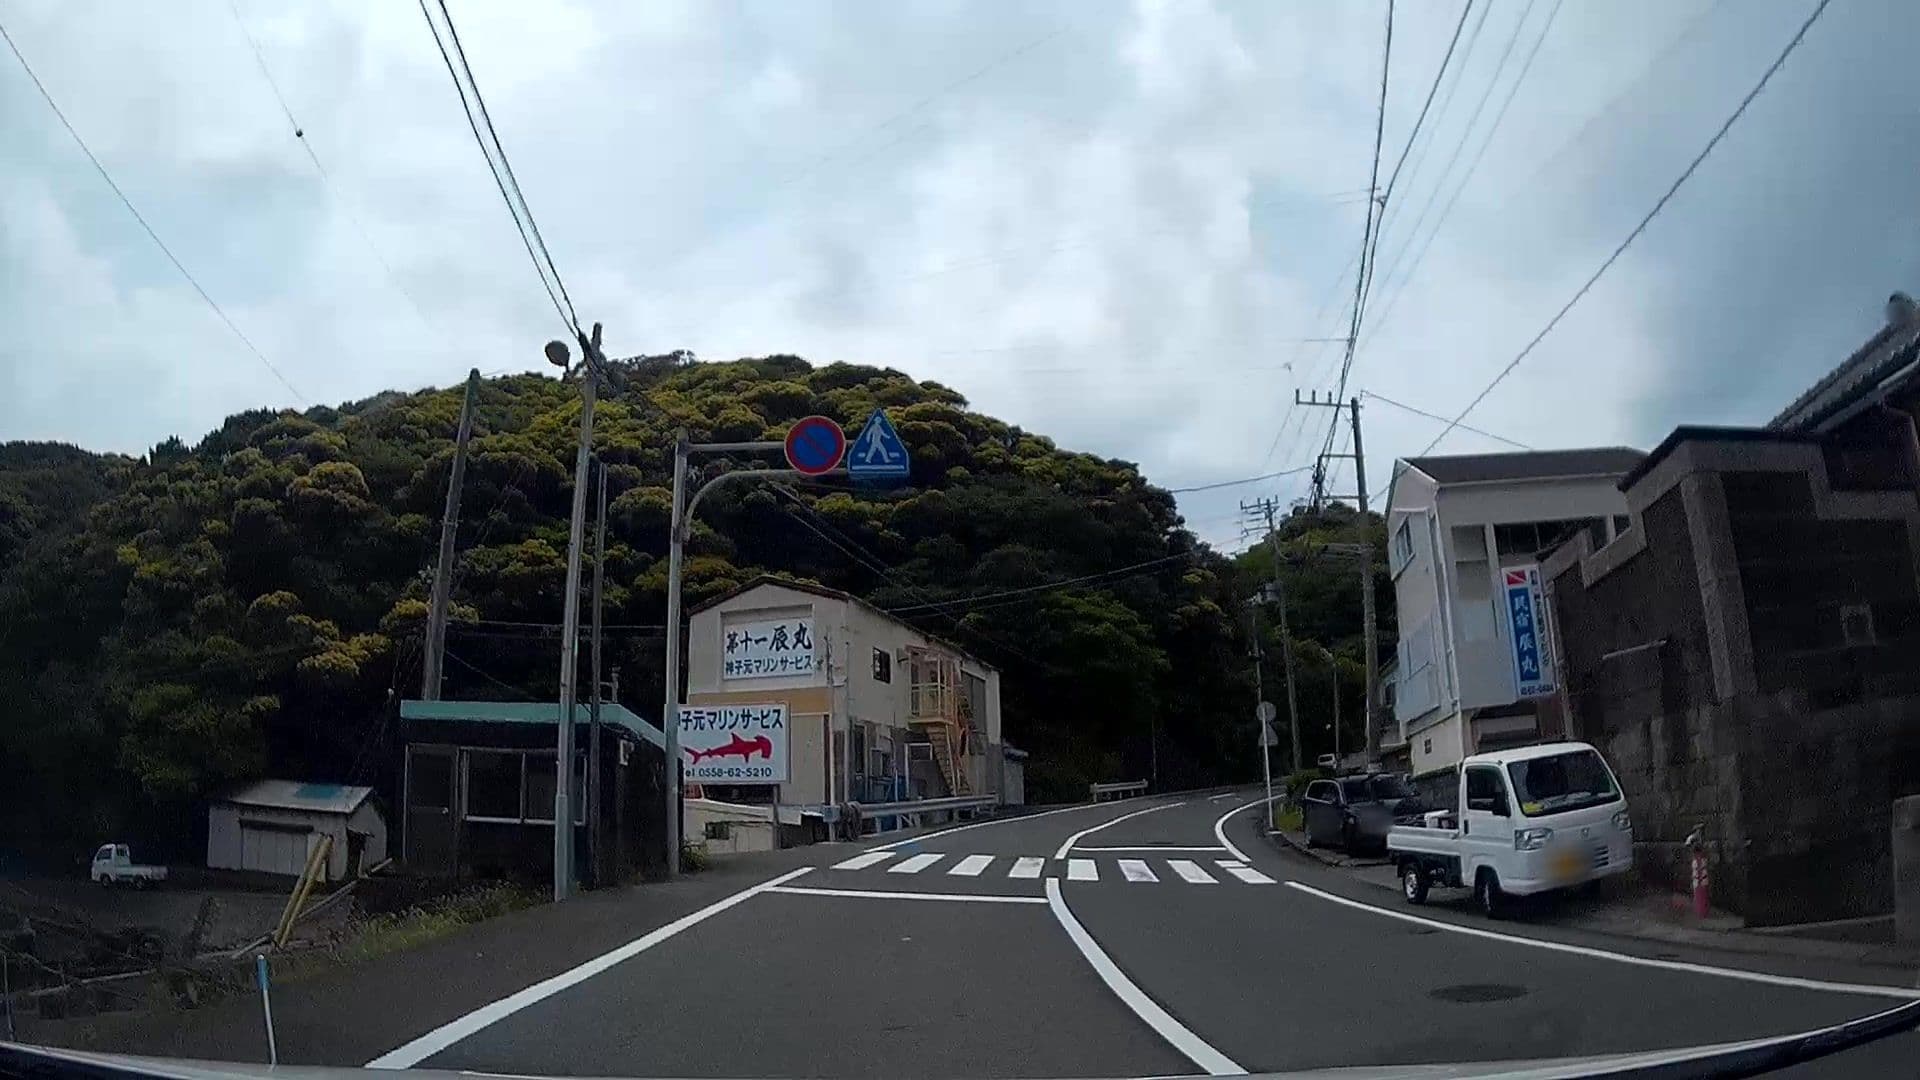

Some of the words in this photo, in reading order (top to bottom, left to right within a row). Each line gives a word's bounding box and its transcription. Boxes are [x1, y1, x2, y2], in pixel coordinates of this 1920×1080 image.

[726, 622, 812, 654] 第十一辰丸
[726, 655, 812, 675] 神子元マリンサービス
[678, 708, 783, 731] 子元マリンサービス
[684, 767, 695, 777] el
[698, 767, 772, 777] 0558-62-5210
